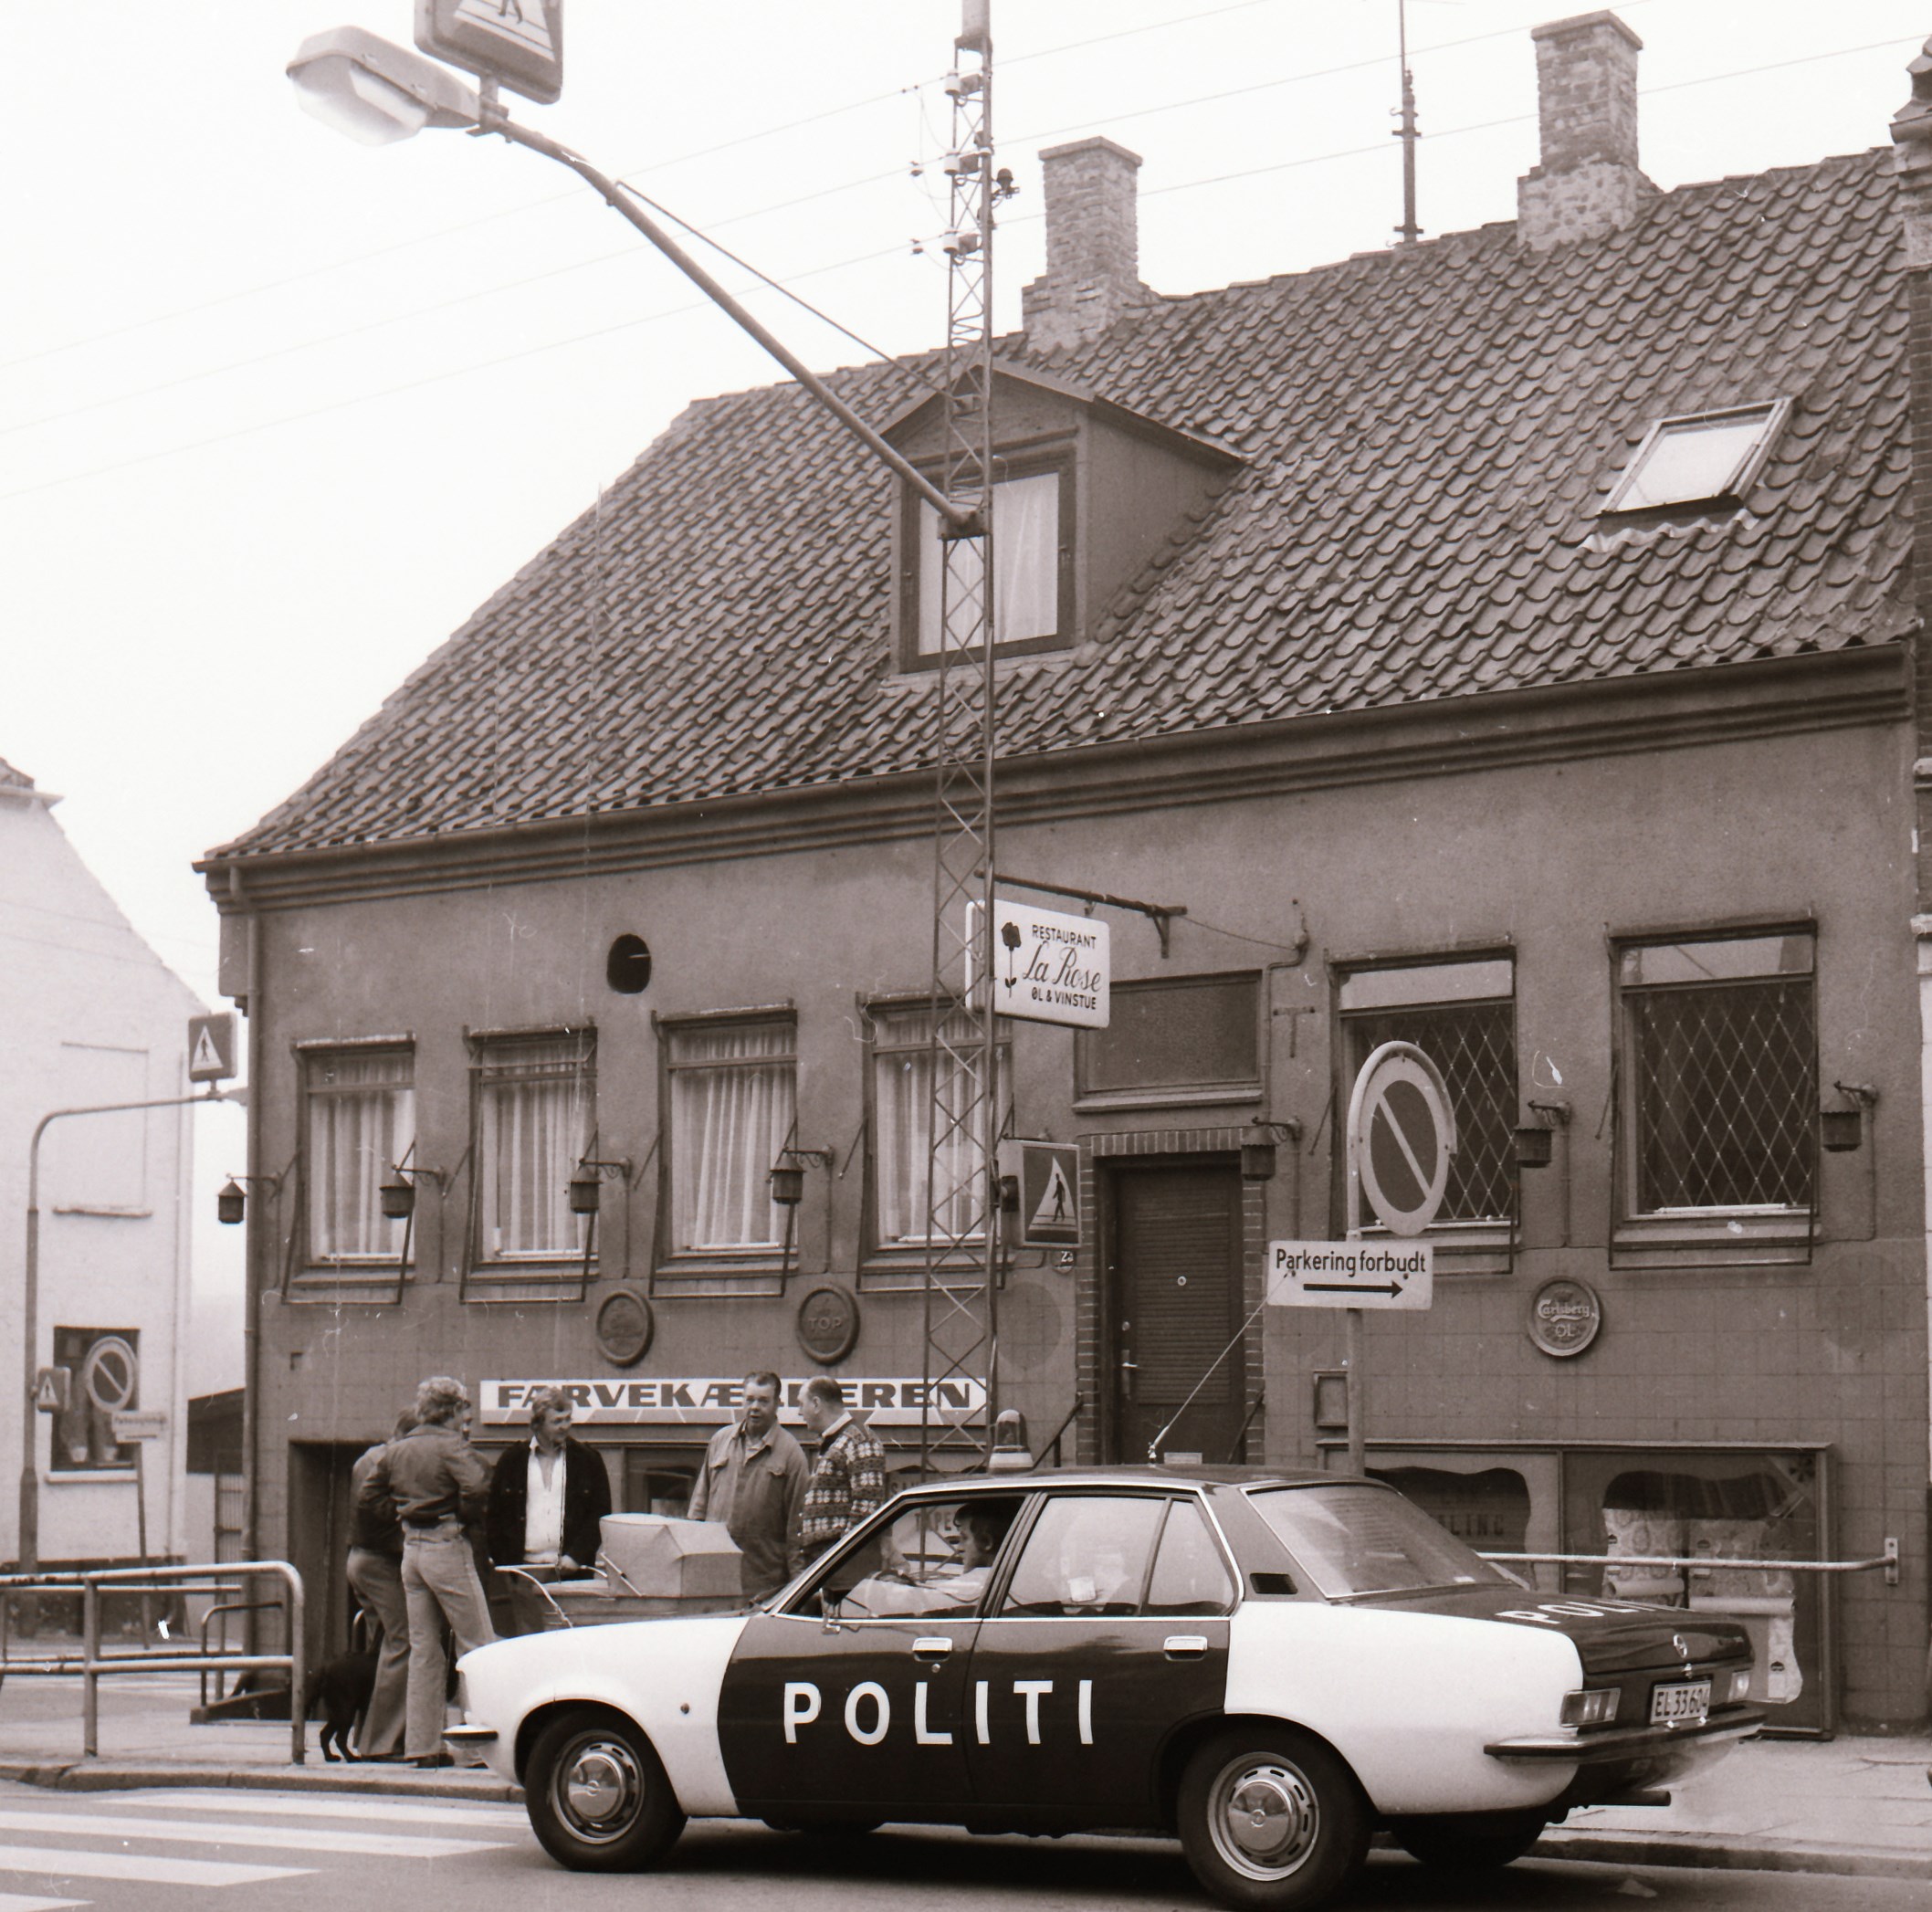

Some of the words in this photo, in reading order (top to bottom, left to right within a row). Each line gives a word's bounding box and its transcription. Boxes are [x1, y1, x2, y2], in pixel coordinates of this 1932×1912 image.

[1032, 924, 1097, 949] RESTAURANT
[1023, 940, 1050, 982] La
[1053, 947, 1101, 993] Rose
[1031, 986, 1044, 1002] ØL
[1046, 989, 1053, 1003] &
[1055, 991, 1097, 1010] VINSTUE
[1276, 1248, 1356, 1277] Parkering
[1360, 1250, 1426, 1273] forbudt
[1538, 1298, 1590, 1320] Carlsberg
[807, 1317, 843, 1332] TOP
[498, 1382, 971, 1408] FRVEKÆEREN
[783, 1679, 1094, 1746] POLITI
